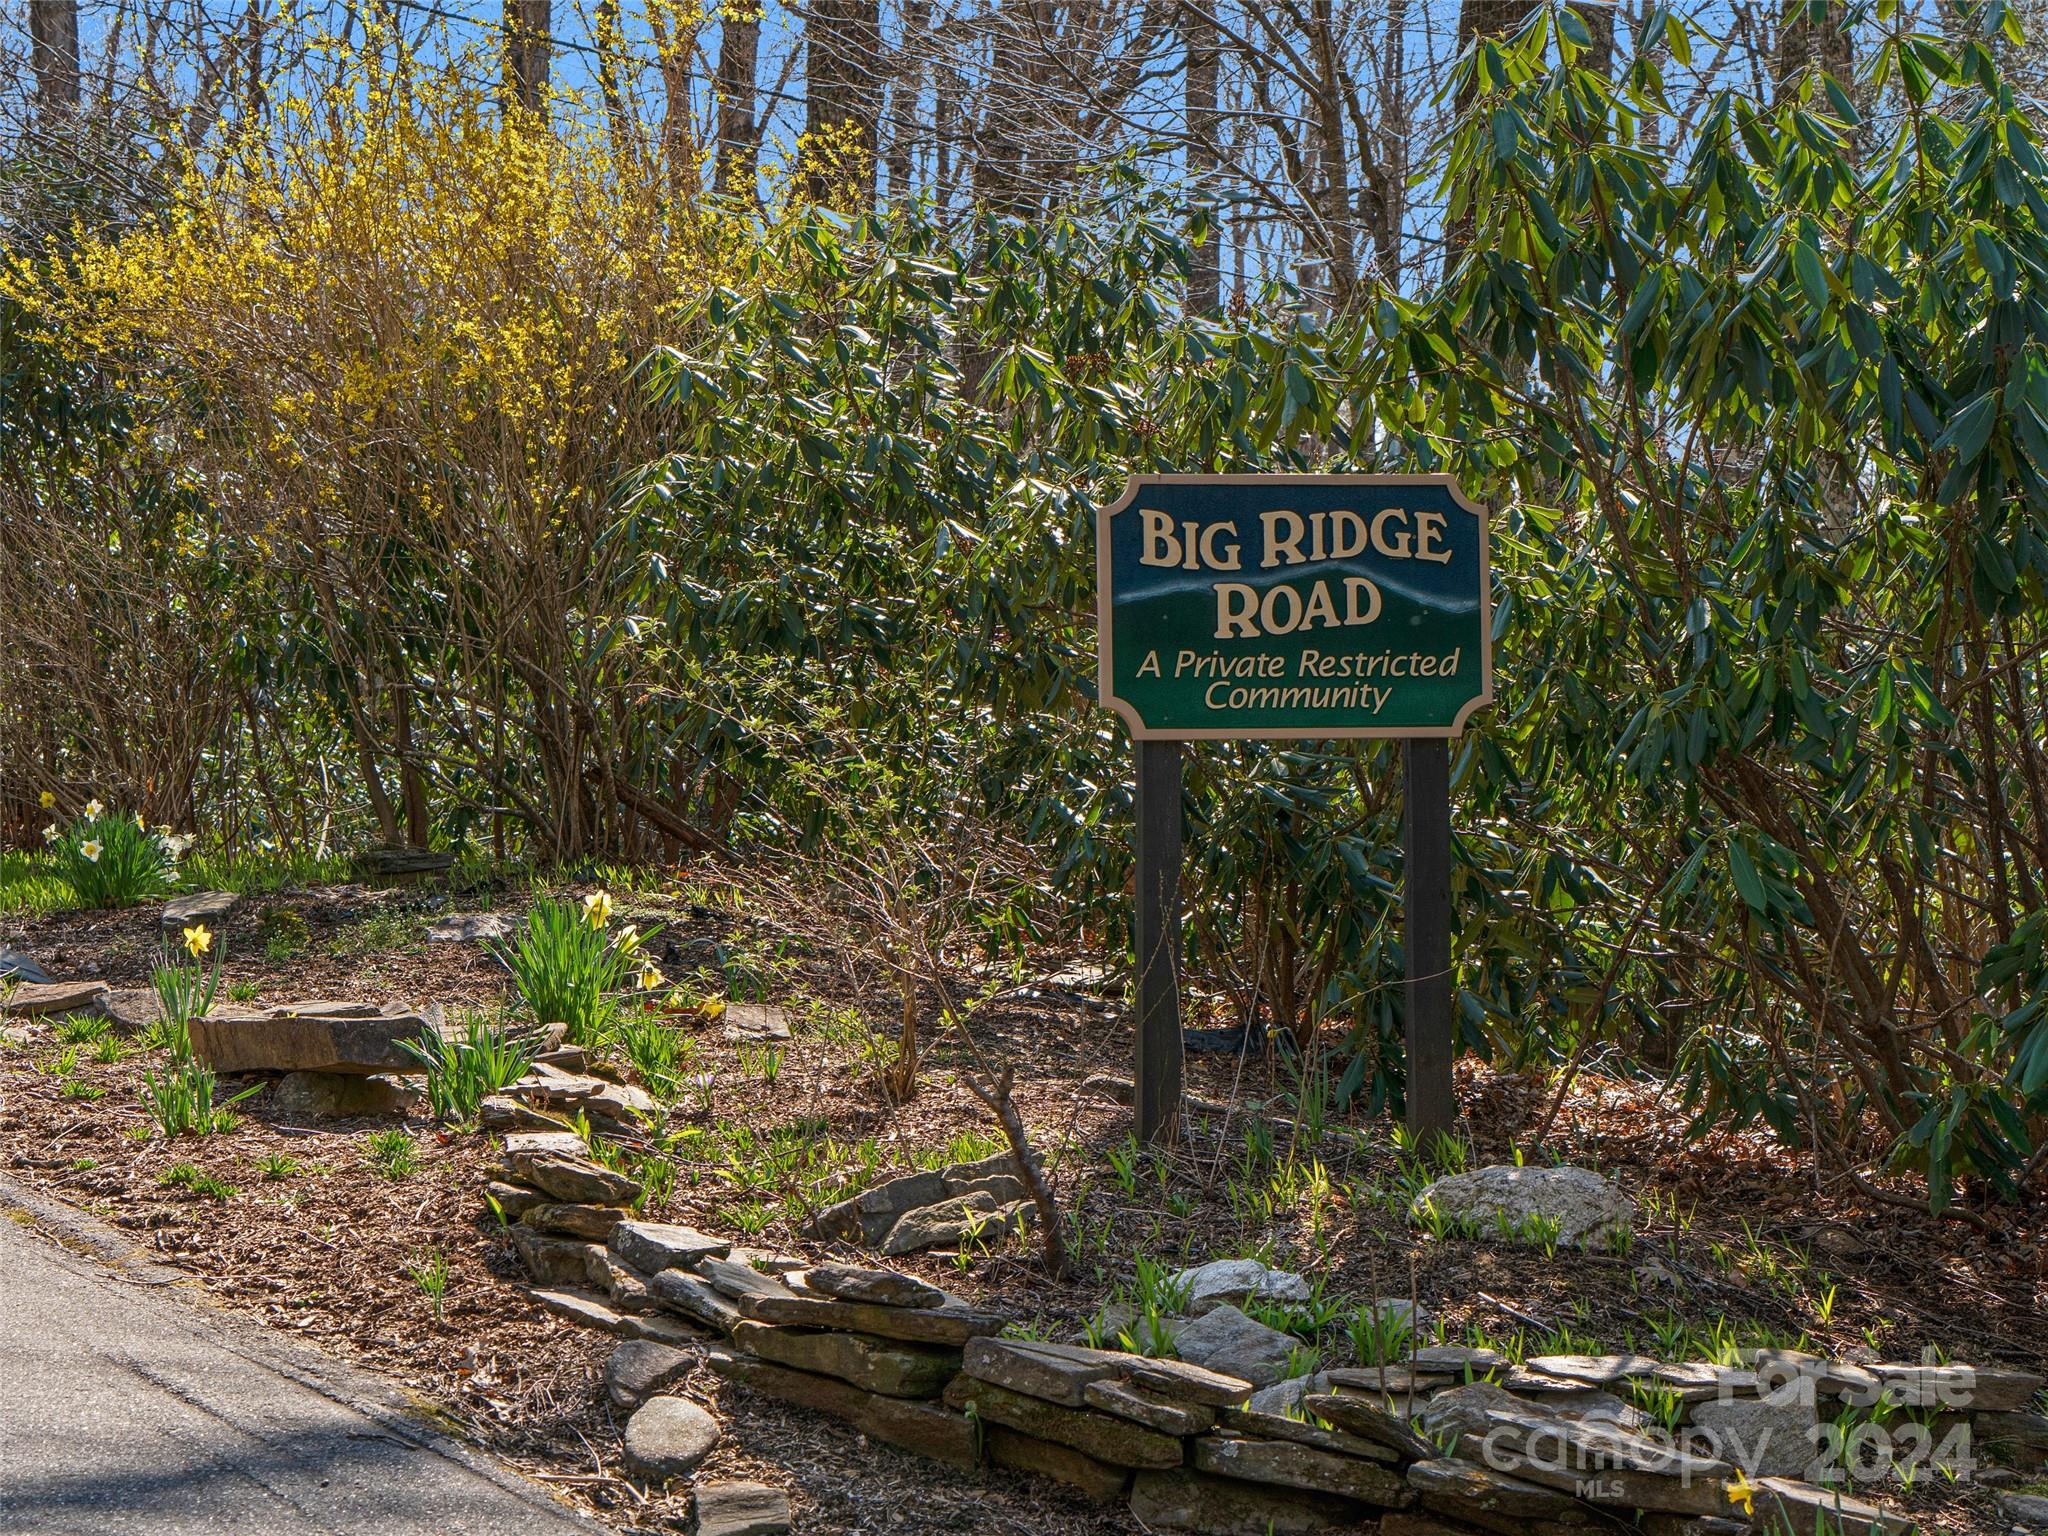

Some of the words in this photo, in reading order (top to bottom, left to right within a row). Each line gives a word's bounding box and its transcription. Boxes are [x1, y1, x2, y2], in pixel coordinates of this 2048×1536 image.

[1138, 508, 1242, 571] BIG
[1259, 507, 1453, 569] RIDGE
[1213, 577, 1383, 640] ROAD
[1136, 650, 1162, 679] A
[1174, 649, 1286, 679] Private
[1298, 647, 1462, 678] Restricted
[1203, 680, 1394, 715] Community
